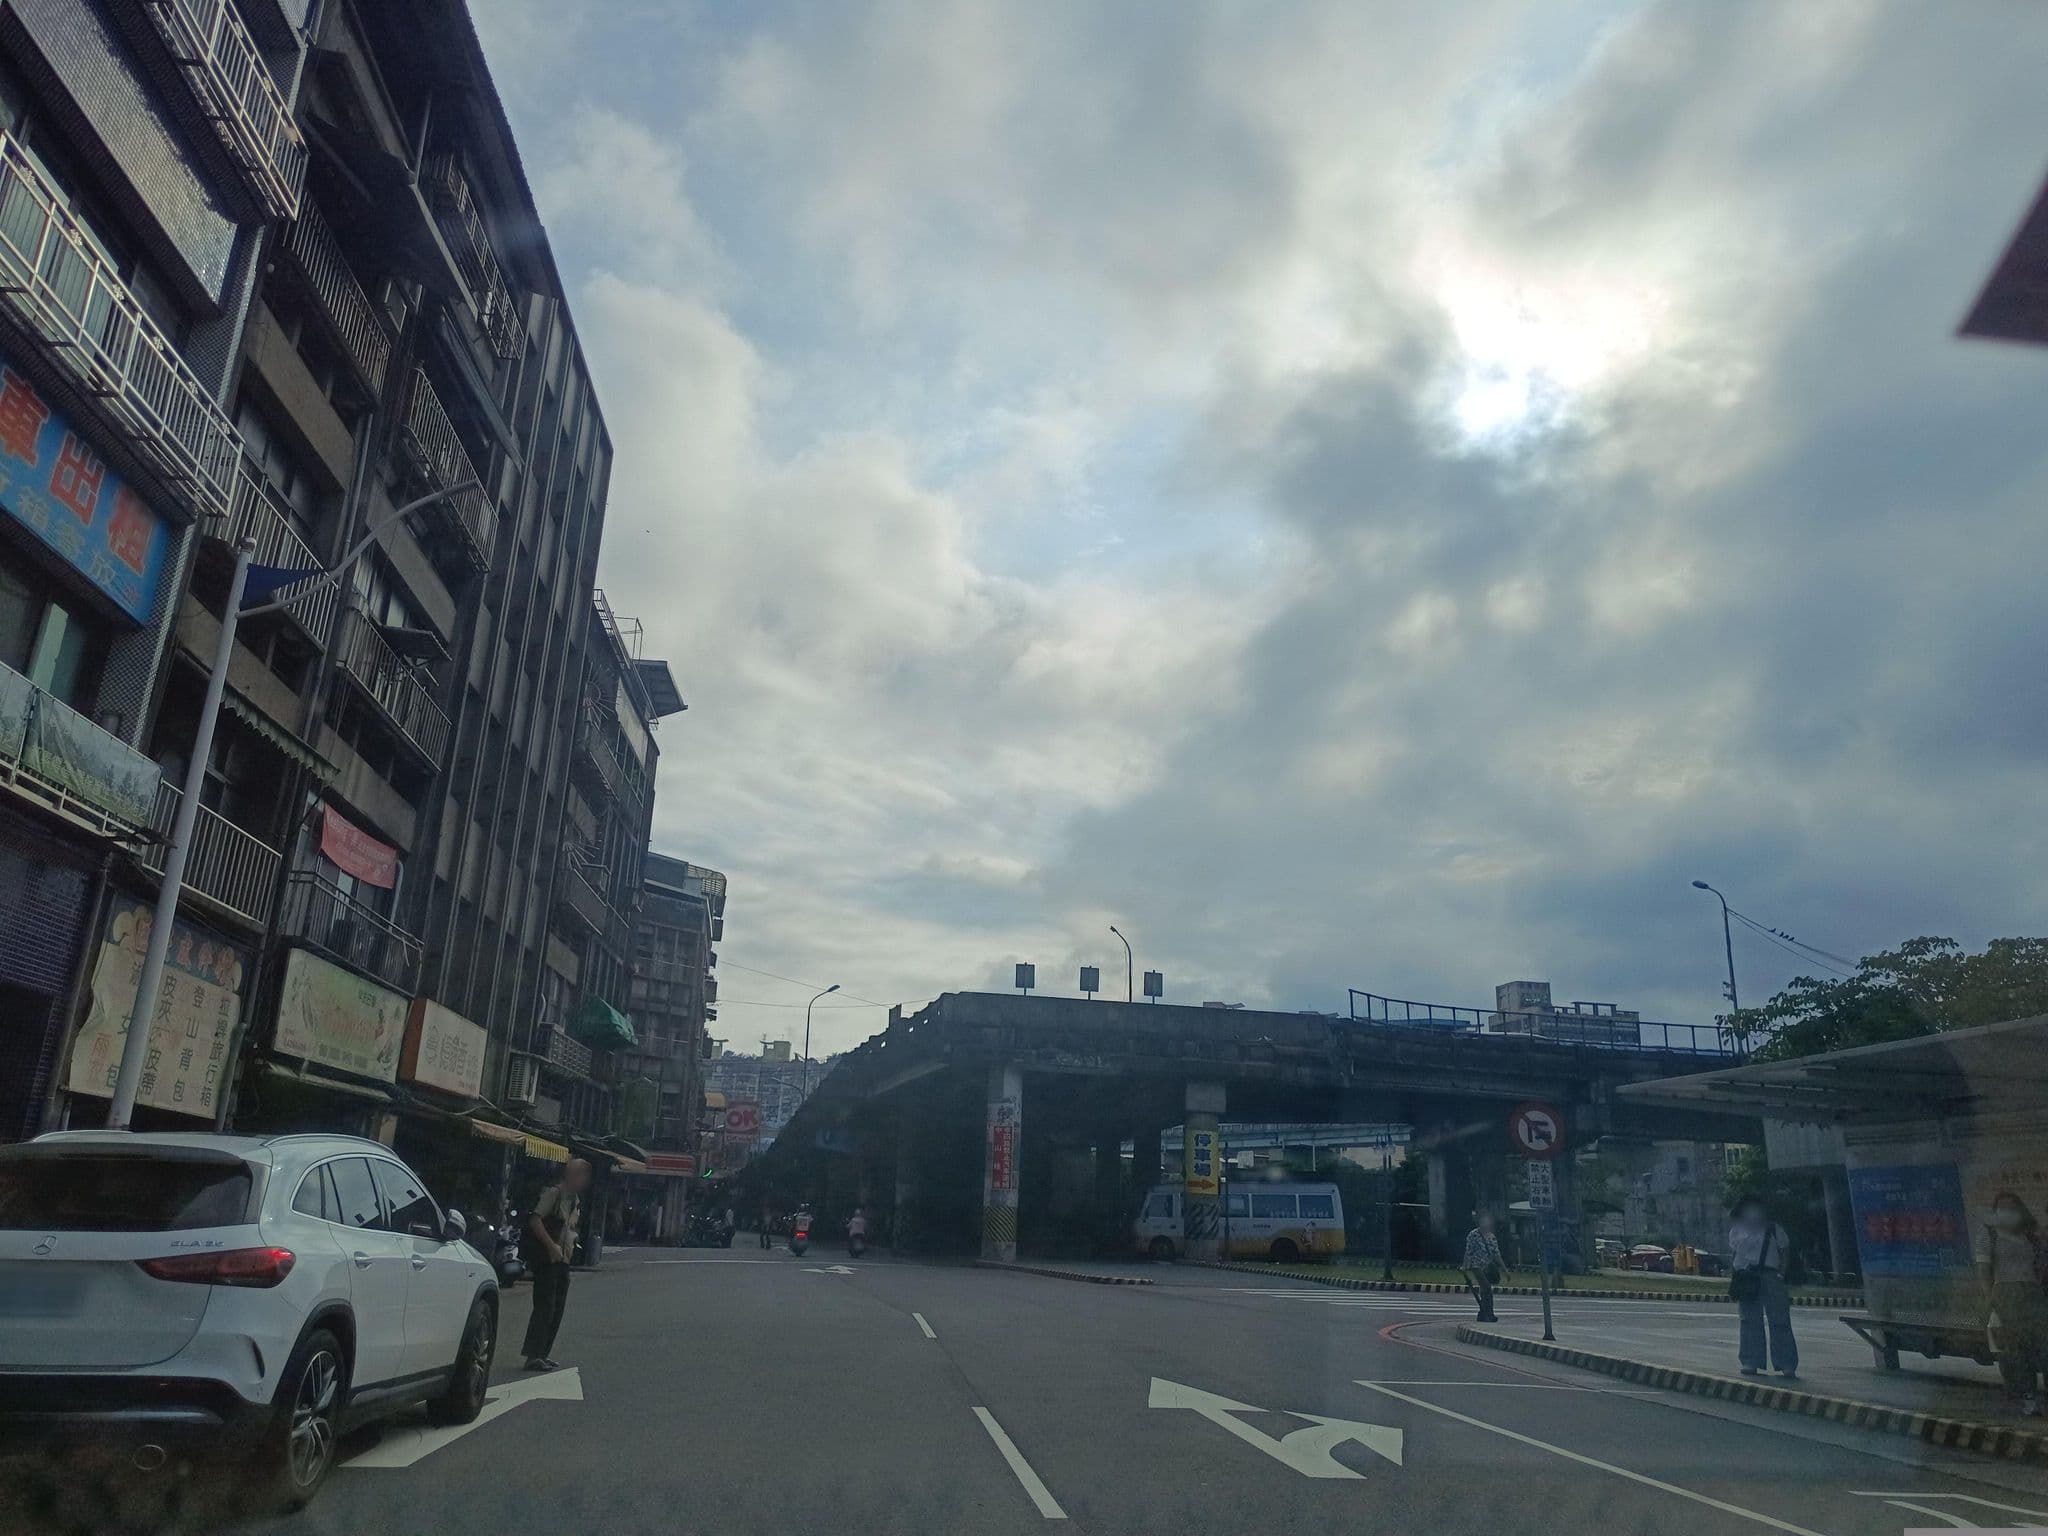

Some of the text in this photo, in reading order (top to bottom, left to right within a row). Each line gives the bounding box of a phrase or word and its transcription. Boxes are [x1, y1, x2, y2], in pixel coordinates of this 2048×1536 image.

[727, 1109, 759, 1126] OK
[1193, 1133, 1211, 1176] 停車場
